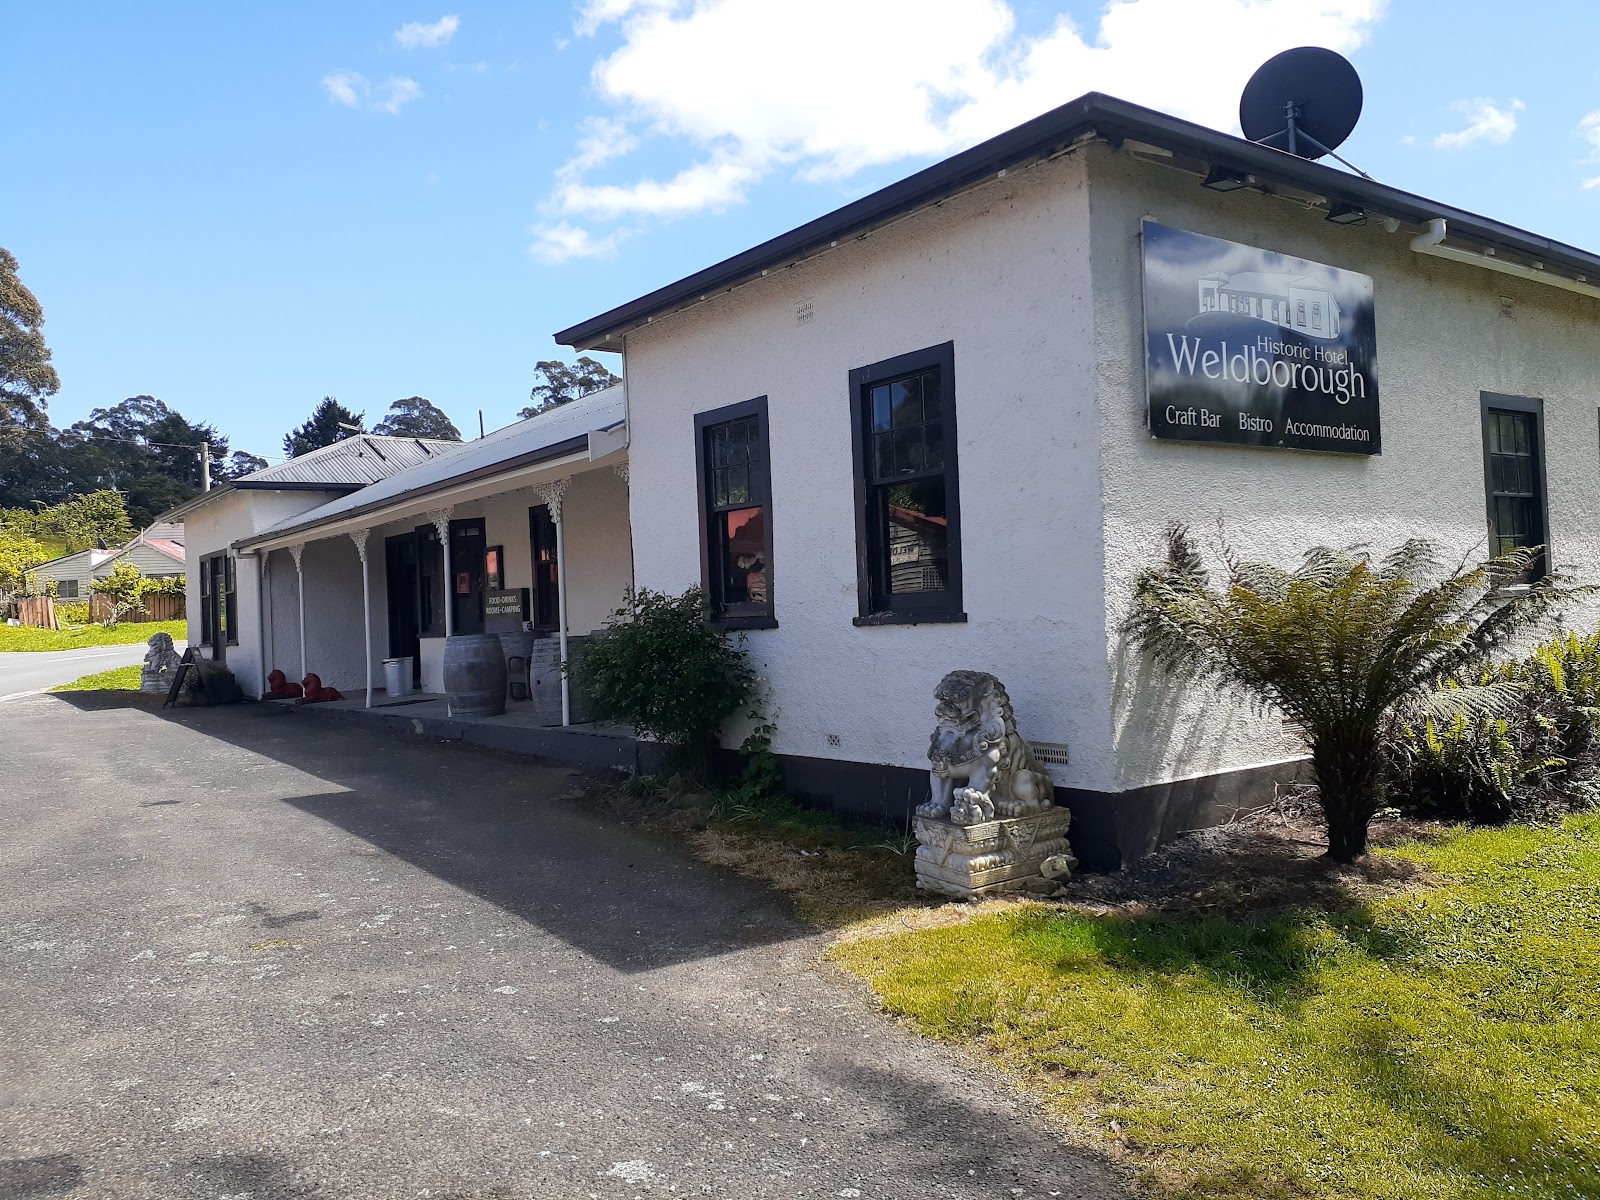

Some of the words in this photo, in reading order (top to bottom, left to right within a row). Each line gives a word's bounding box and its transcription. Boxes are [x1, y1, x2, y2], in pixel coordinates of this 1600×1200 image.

[1166, 333, 1366, 405] Weldborough
[1257, 335, 1311, 360] Historic
[1314, 345, 1348, 366] Hotel
[1165, 405, 1197, 426] Craft
[1200, 408, 1221, 428] Bar
[1239, 412, 1273, 433] Bistro
[1285, 417, 1370, 442] Accommodation
